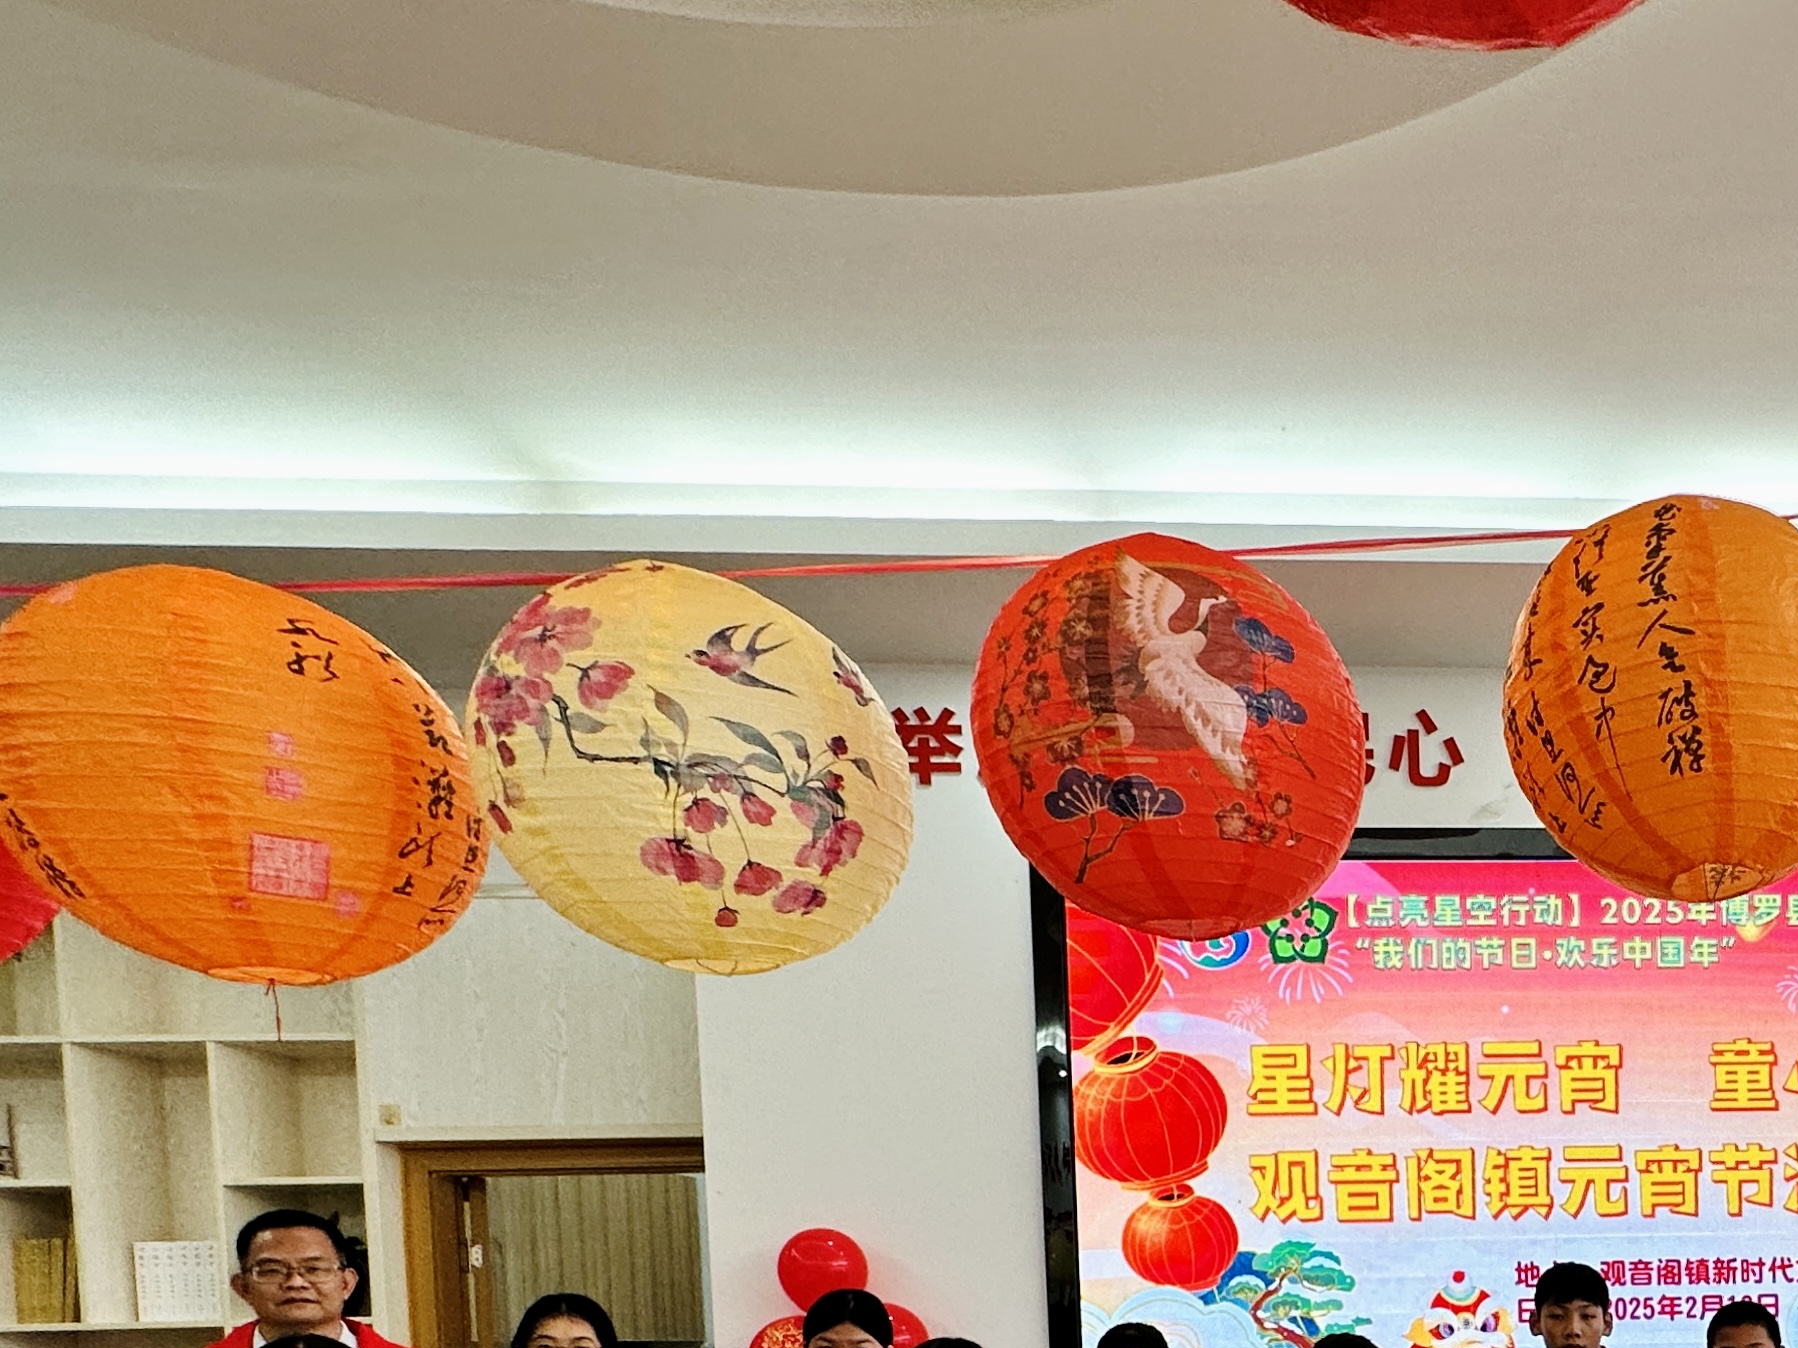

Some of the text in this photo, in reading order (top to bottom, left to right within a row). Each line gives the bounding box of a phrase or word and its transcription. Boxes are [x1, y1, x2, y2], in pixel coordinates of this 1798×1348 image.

[1246, 1040, 1624, 1116] 星灯耀元宵
